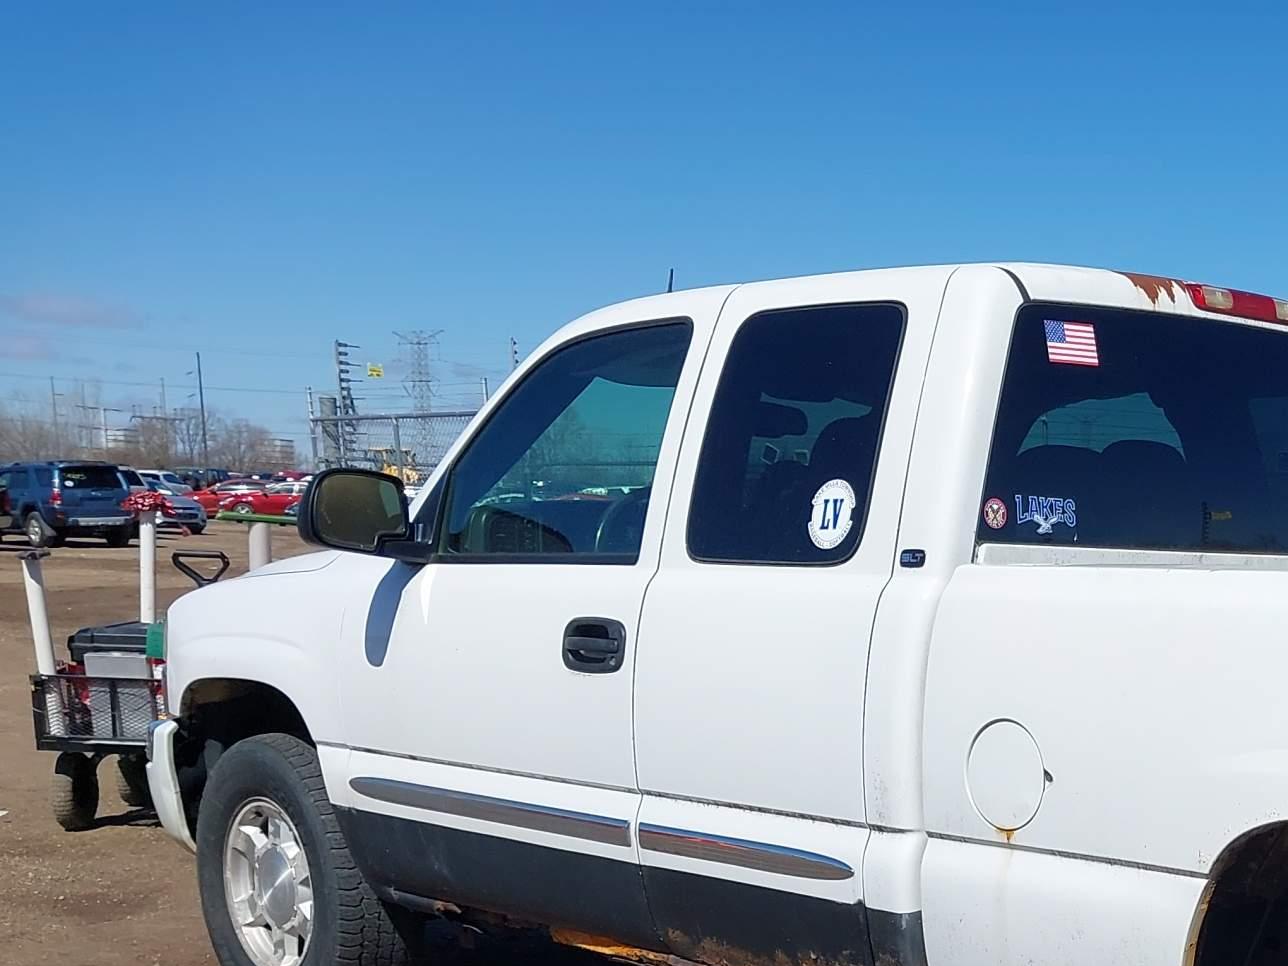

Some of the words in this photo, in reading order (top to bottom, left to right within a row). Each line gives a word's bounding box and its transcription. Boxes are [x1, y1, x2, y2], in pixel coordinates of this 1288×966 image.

[819, 498, 845, 530] LV
[1014, 494, 1077, 528] LAKES
[901, 553, 924, 563] SLT
